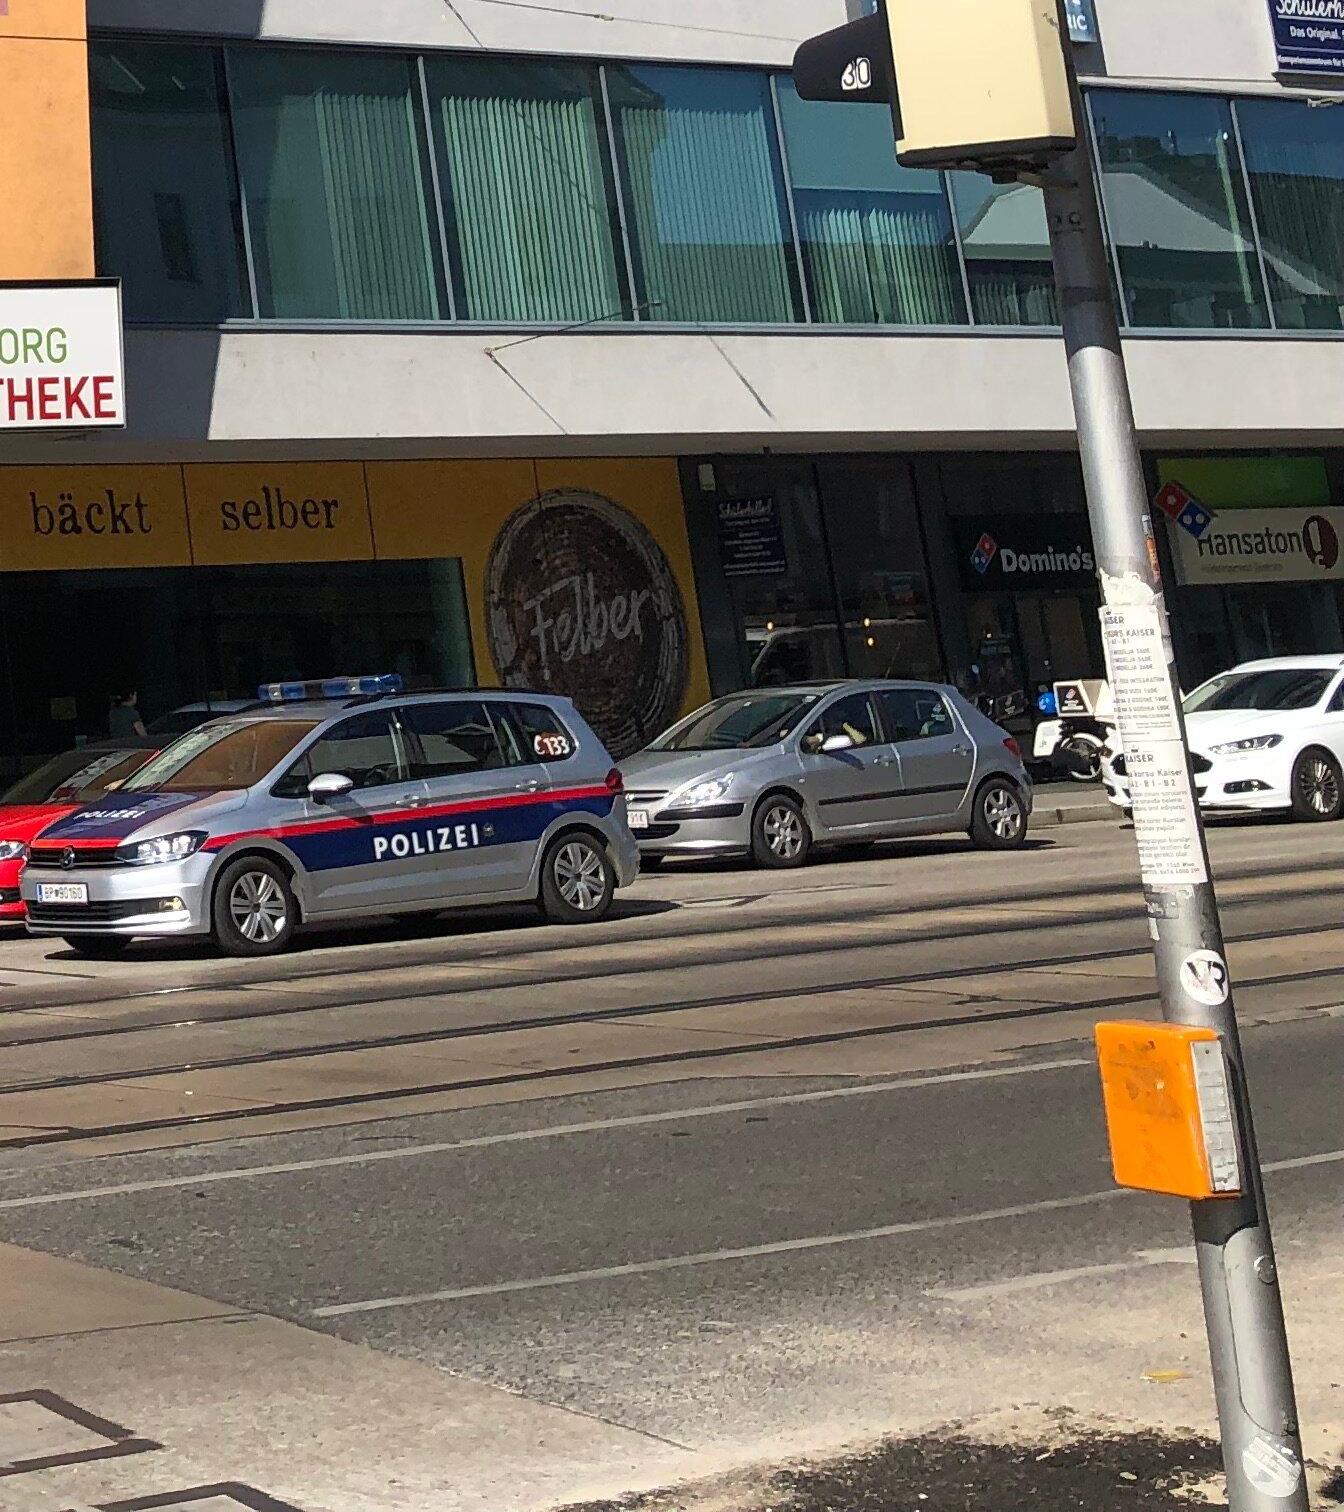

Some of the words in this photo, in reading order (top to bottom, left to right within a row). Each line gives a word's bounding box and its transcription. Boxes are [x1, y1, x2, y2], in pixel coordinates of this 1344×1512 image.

[1290, 25, 1306, 37] Das
[30, 490, 152, 535] bäckt
[221, 486, 339, 531] selber
[1000, 545, 1094, 572] Domino's
[522, 571, 650, 681] Felber
[373, 823, 480, 860] POLIZEI
